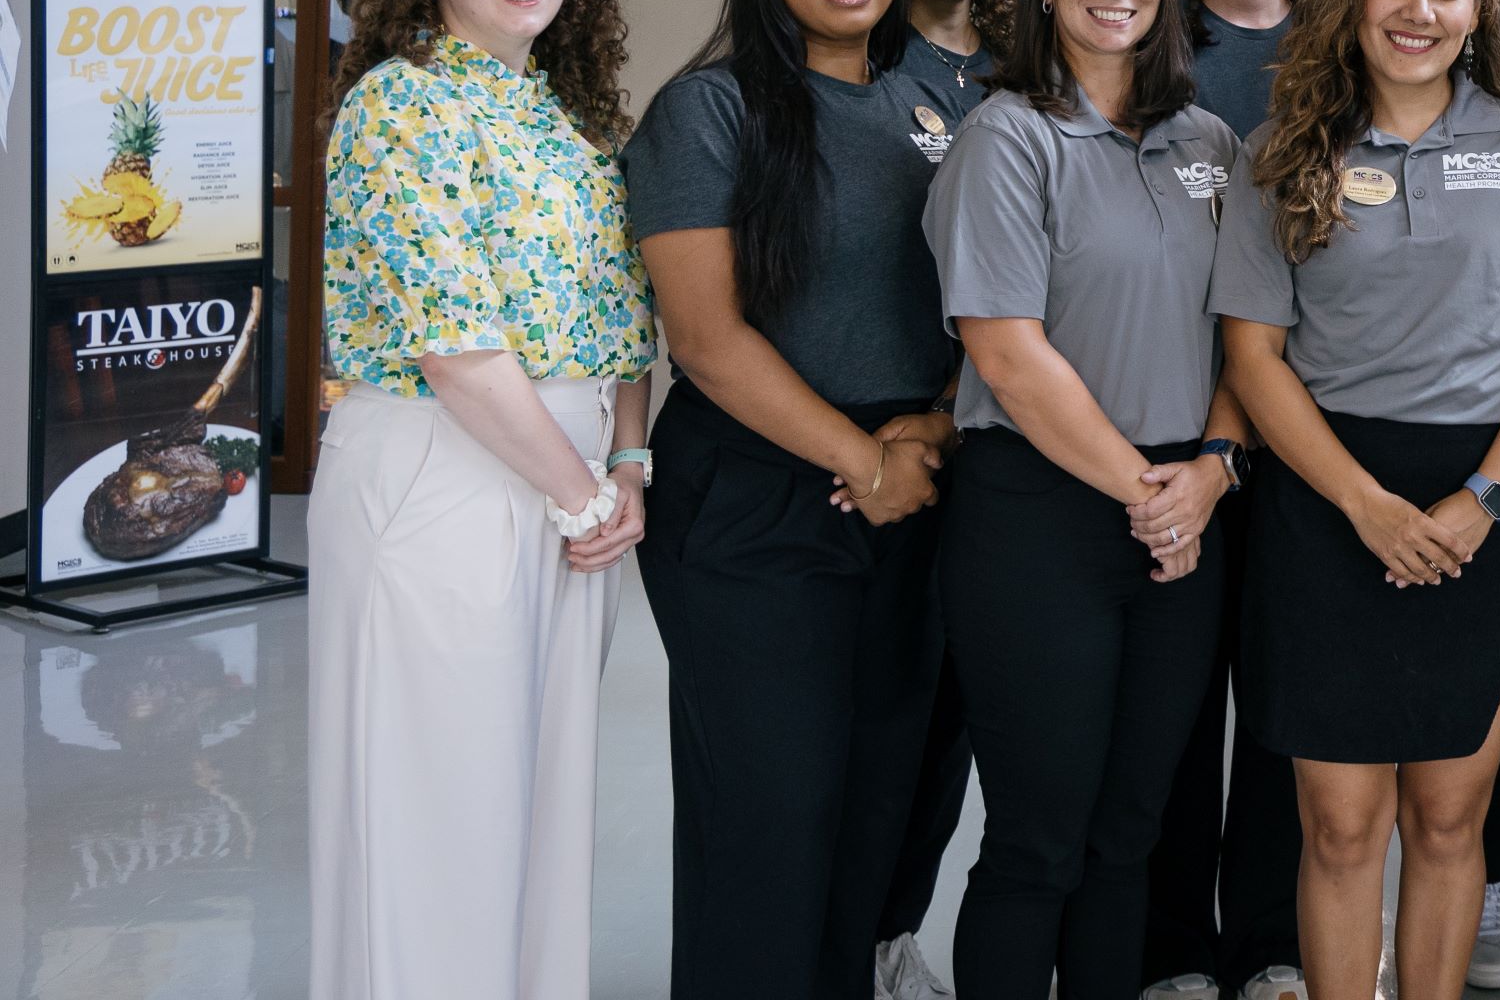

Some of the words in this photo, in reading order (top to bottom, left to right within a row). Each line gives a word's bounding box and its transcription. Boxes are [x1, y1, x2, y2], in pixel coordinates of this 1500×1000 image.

[57, 5, 247, 56] BOOST
[100, 55, 256, 104] JUICE
[1173, 161, 1229, 183] MCS
[1354, 171, 1383, 181] MCCS
[1445, 173, 1475, 182] MARINE
[1446, 182, 1475, 190] HEALTH
[77, 298, 236, 348] TAIYO
[76, 353, 142, 372] STEAK
[170, 344, 235, 362] HOUSE
